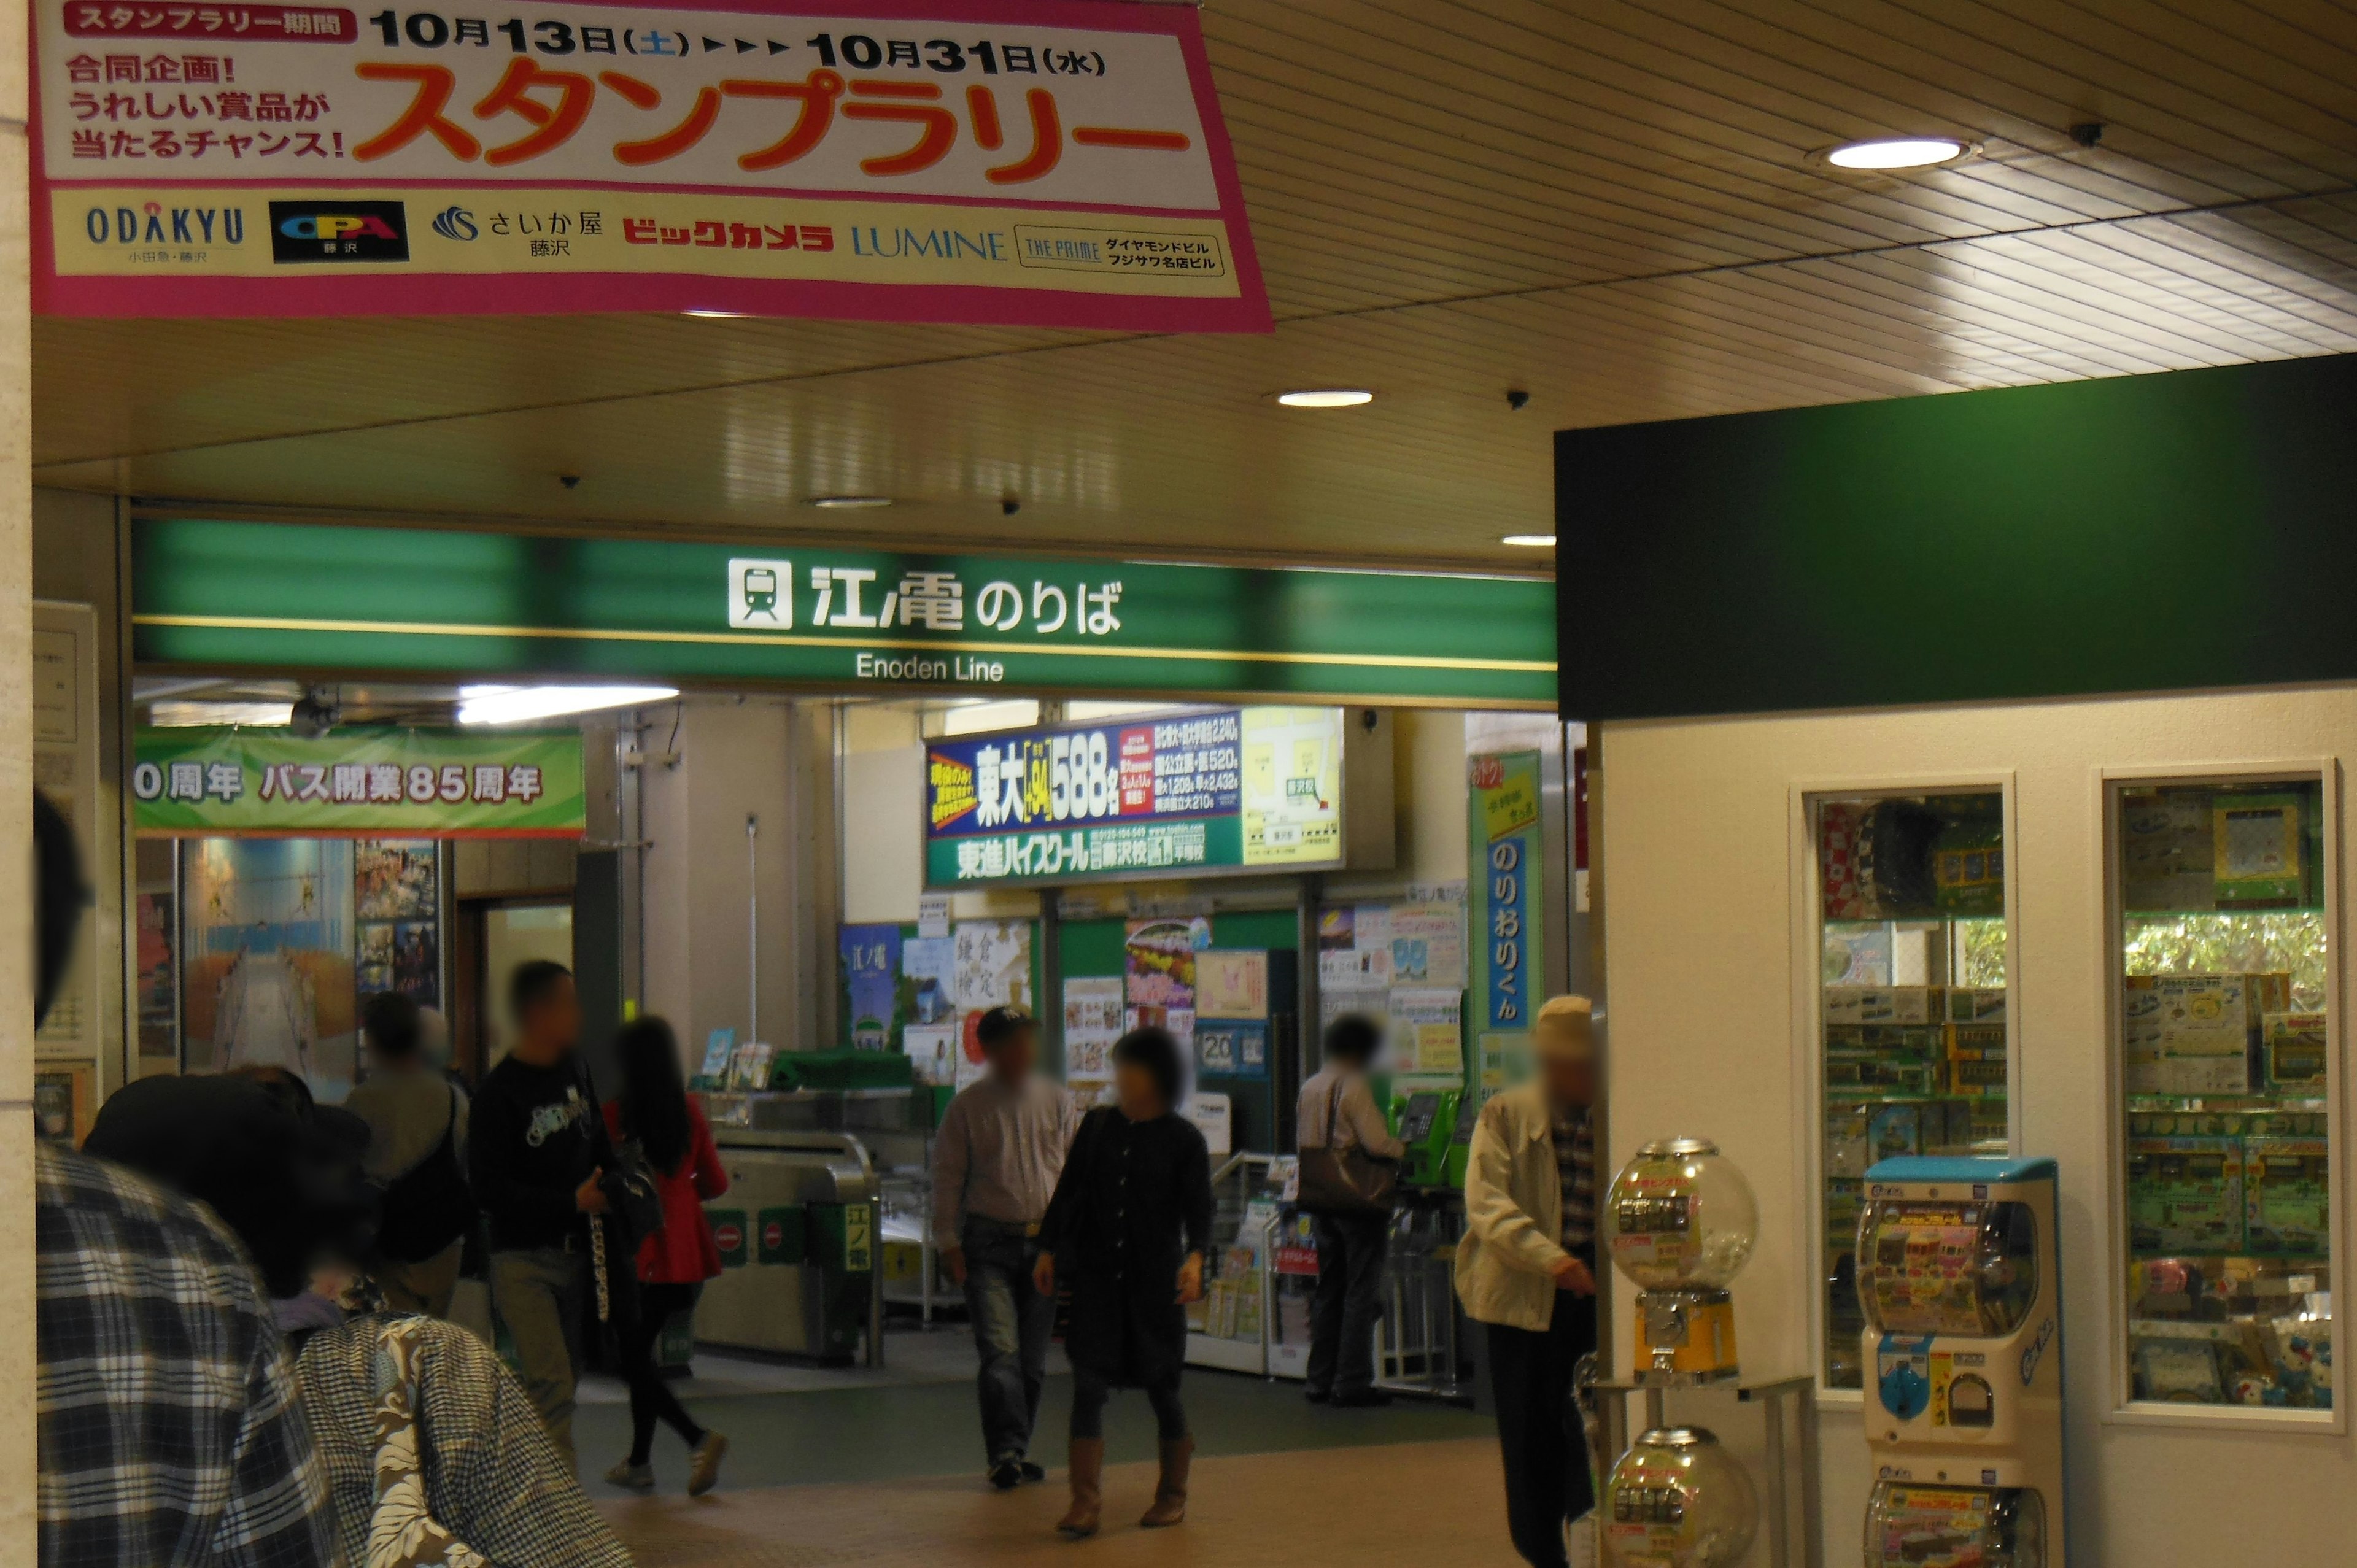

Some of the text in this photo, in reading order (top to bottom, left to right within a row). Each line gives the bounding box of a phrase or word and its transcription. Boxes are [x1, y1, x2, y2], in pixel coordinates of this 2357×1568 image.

[79, 4, 343, 37] スタンプラリー期間
[370, 9, 1106, 77] 10月13日(土) 10月31日(水)
[66, 53, 236, 85] 合同企画!
[68, 90, 331, 124] うれしい賞品が
[352, 55, 1191, 185] スタンプラリー
[71, 129, 344, 161] 当たるチャンス!
[87, 201, 244, 246] ODAKYU
[279, 214, 400, 241] OPA
[490, 211, 603, 237] さいか屋
[623, 217, 834, 251] ビックカメラ
[323, 242, 358, 255] 藤沢
[530, 239, 571, 258] 藤沢
[851, 225, 1009, 263] LUMINE
[1026, 237, 1100, 263] THE PRIME
[1105, 238, 1209, 256] ダイヤモンドビル
[1108, 253, 1216, 271] フジサワ名店ビル
[857, 653, 1004, 682] Enoden Line
[259, 762, 544, 806] バス開業85周年
[977, 744, 1024, 827] 東大
[957, 831, 1089, 879] 東進ハイスクール
[1492, 843, 1520, 1021] のりおりくん
